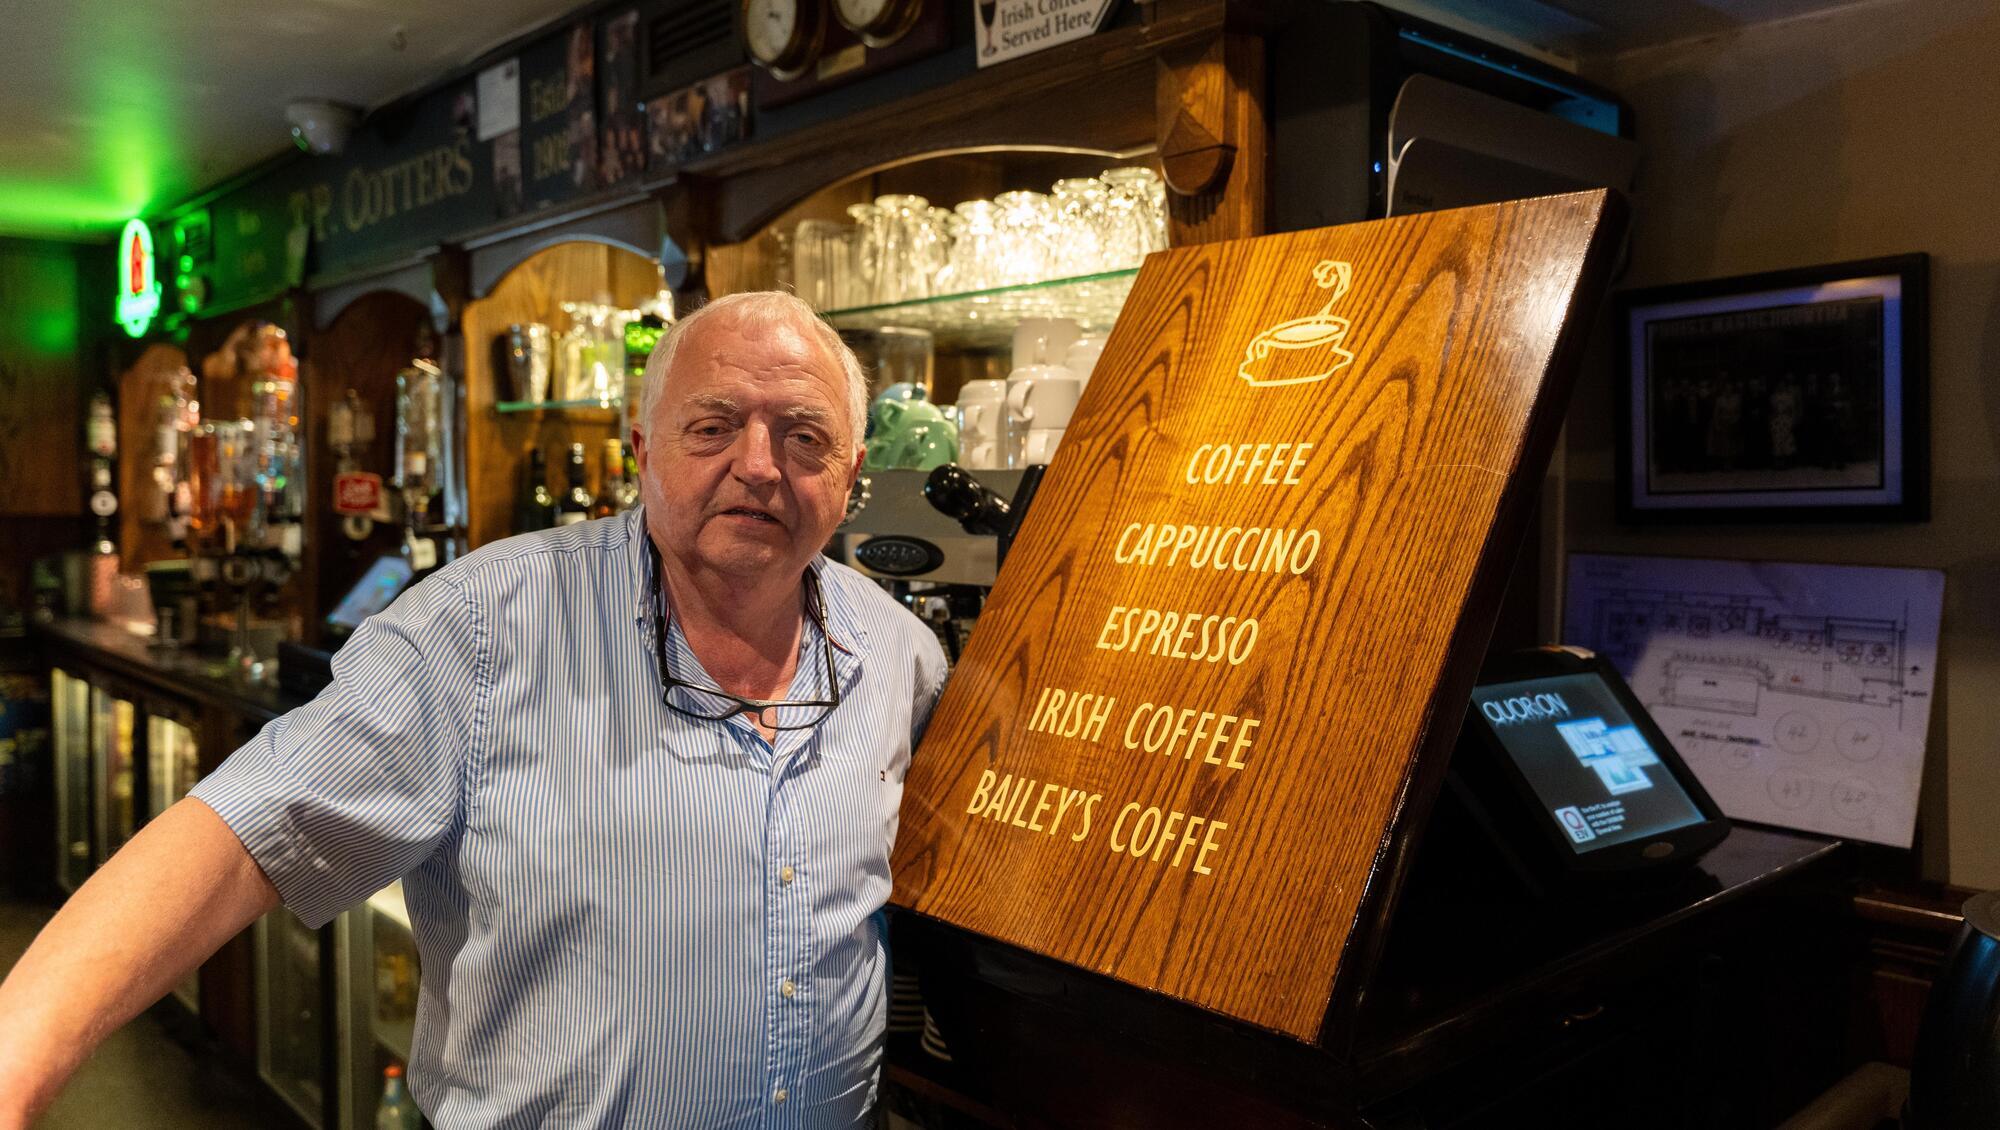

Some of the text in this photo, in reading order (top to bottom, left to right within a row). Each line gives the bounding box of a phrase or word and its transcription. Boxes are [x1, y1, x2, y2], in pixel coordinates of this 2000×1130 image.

[1001, 5, 1034, 28] Irish
[1002, 11, 1093, 50] Served Here
[1185, 442, 1315, 486] COFFEE
[1114, 522, 1322, 575] CAPPUCCINO
[1095, 606, 1260, 666] ESPRESSO
[1028, 687, 1262, 770] IRISH COFFEE
[966, 769, 1229, 876] BAILEY'S COFFE
